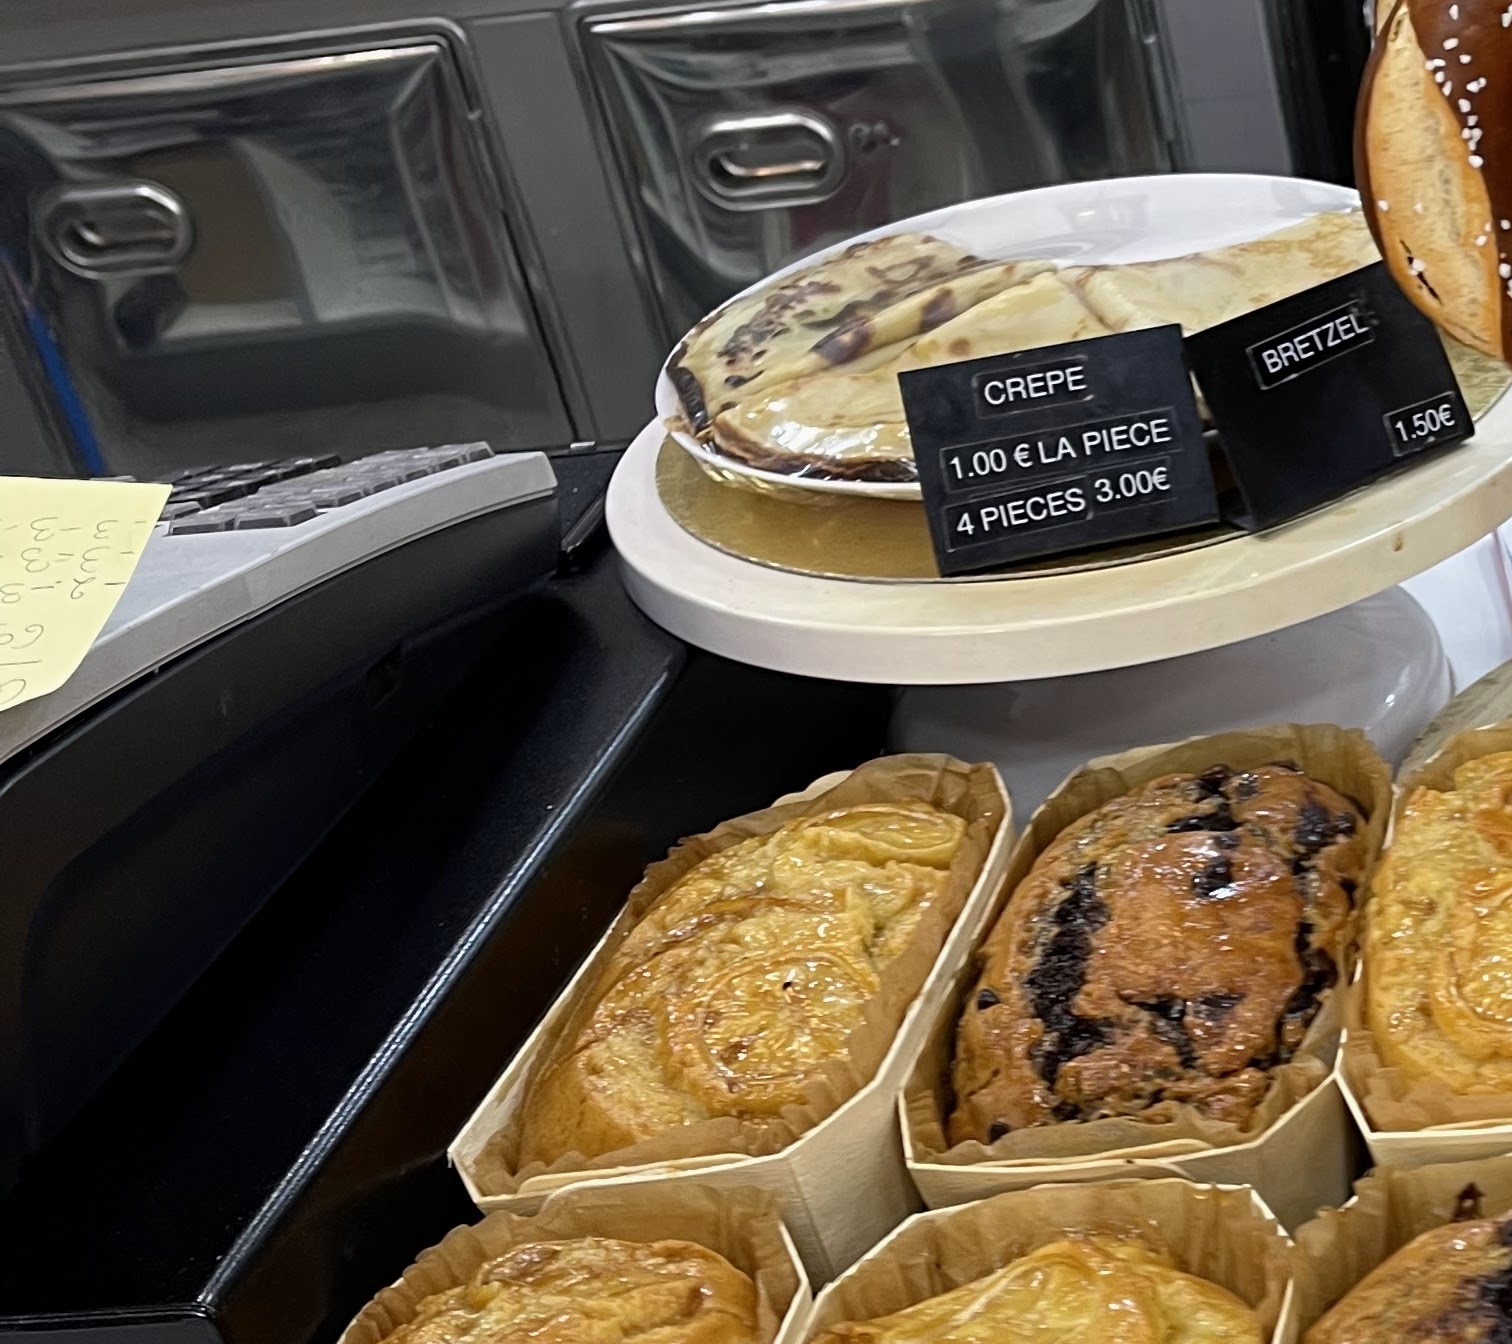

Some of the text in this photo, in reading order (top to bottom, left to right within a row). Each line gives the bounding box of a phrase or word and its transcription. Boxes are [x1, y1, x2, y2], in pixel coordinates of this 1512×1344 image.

[1261, 312, 1370, 374] BRETZEL
[983, 365, 1087, 406] CREPE
[950, 418, 1172, 479] 1.00 € LA PIECE
[1394, 403, 1455, 442] 1.50€
[956, 466, 1171, 535] 4 PIECES 3.00€
